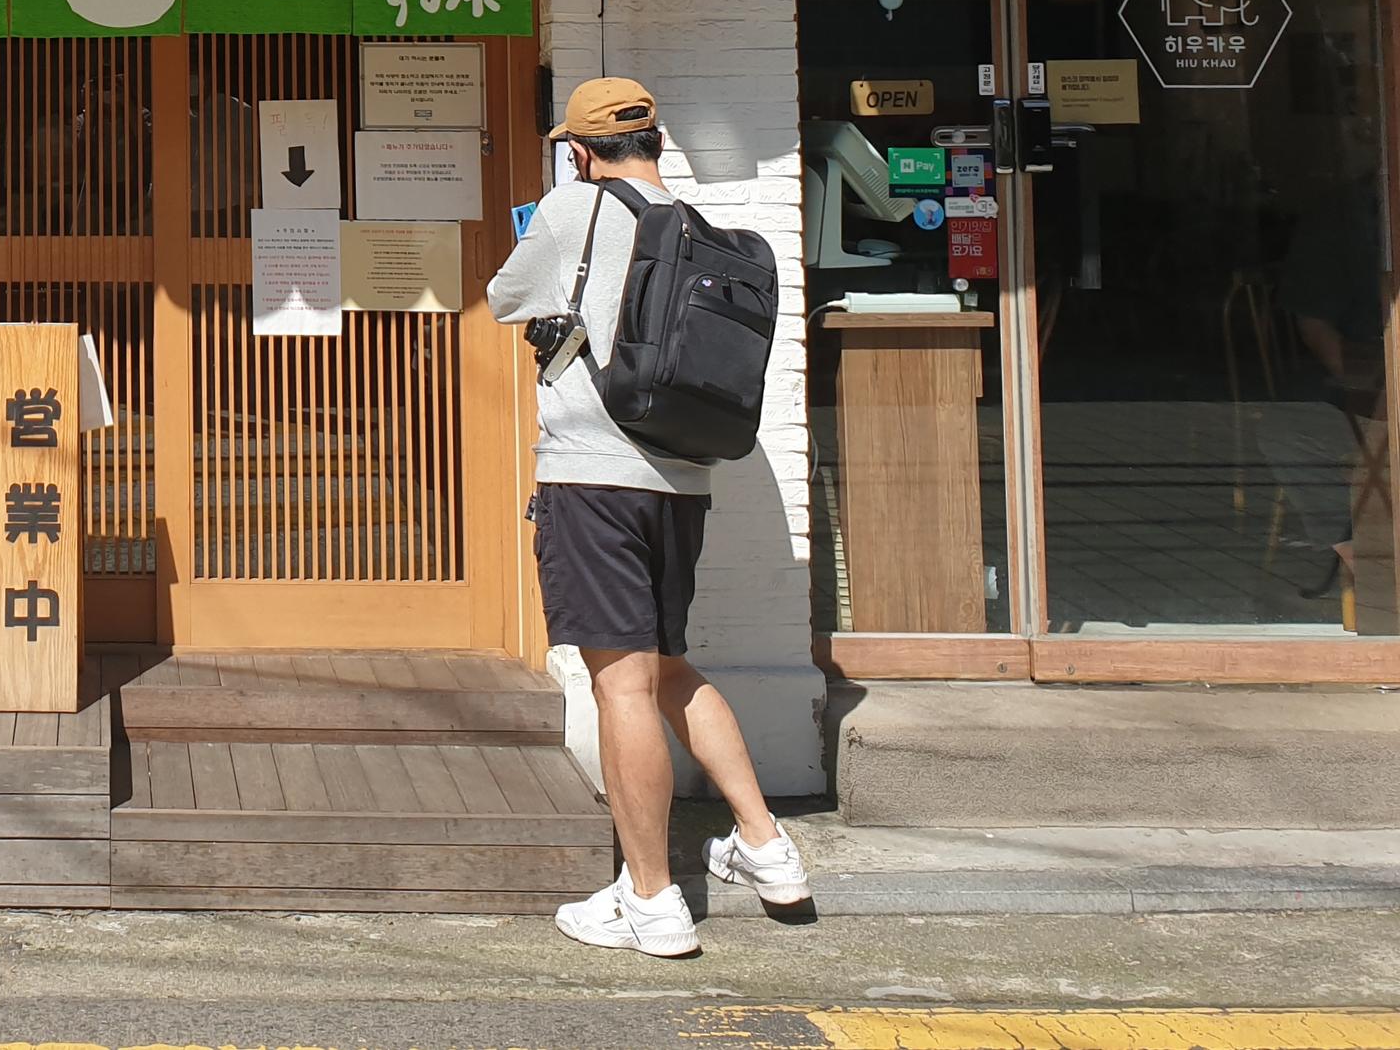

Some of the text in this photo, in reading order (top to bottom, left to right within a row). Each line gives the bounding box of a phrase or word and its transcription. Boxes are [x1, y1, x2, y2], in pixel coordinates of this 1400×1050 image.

[1164, 35, 1246, 53] 히우카우
[1176, 58, 1237, 68] HIU KHAU
[866, 91, 918, 109] OPEN
[916, 161, 935, 172] Pay
[951, 232, 982, 245] 배달은
[952, 245, 983, 256] 요기요
[5, 387, 62, 642] 営業中
